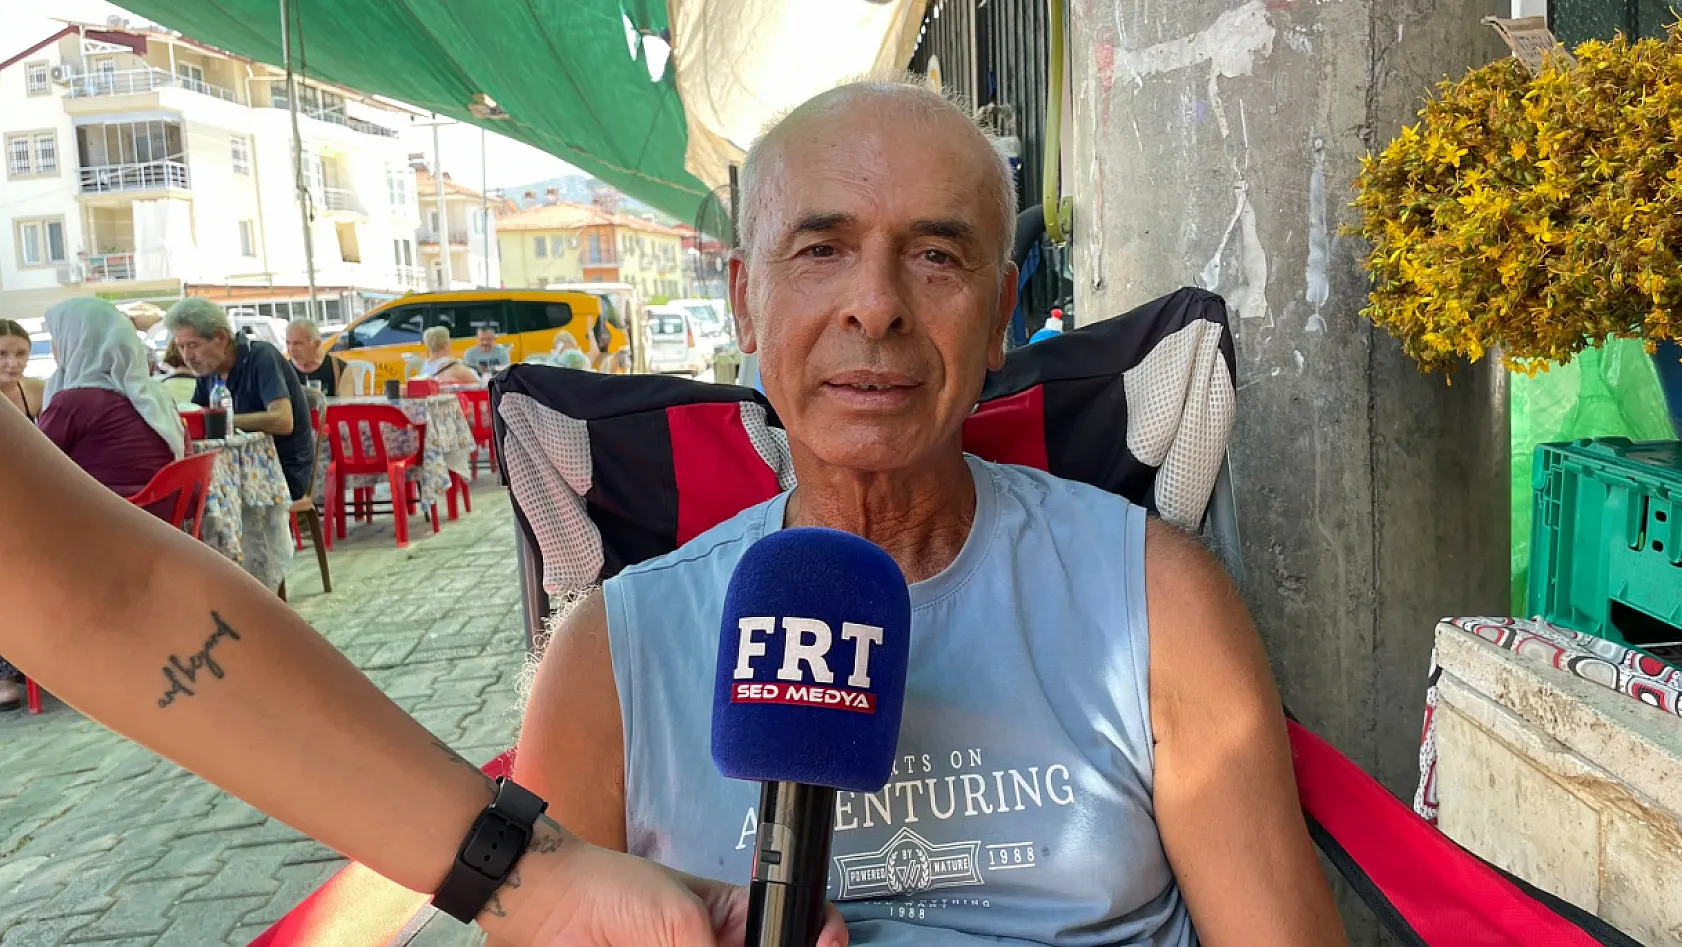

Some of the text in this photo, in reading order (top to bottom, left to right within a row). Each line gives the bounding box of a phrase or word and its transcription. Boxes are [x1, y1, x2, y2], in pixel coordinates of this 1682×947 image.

[733, 616, 884, 689] FRT
[737, 684, 870, 709] SED MEDYA
[950, 748, 983, 769] ON
[850, 849, 969, 883] POWERED BY NATURE
[988, 847, 1035, 865] 1988
[889, 905, 926, 919] 1988
